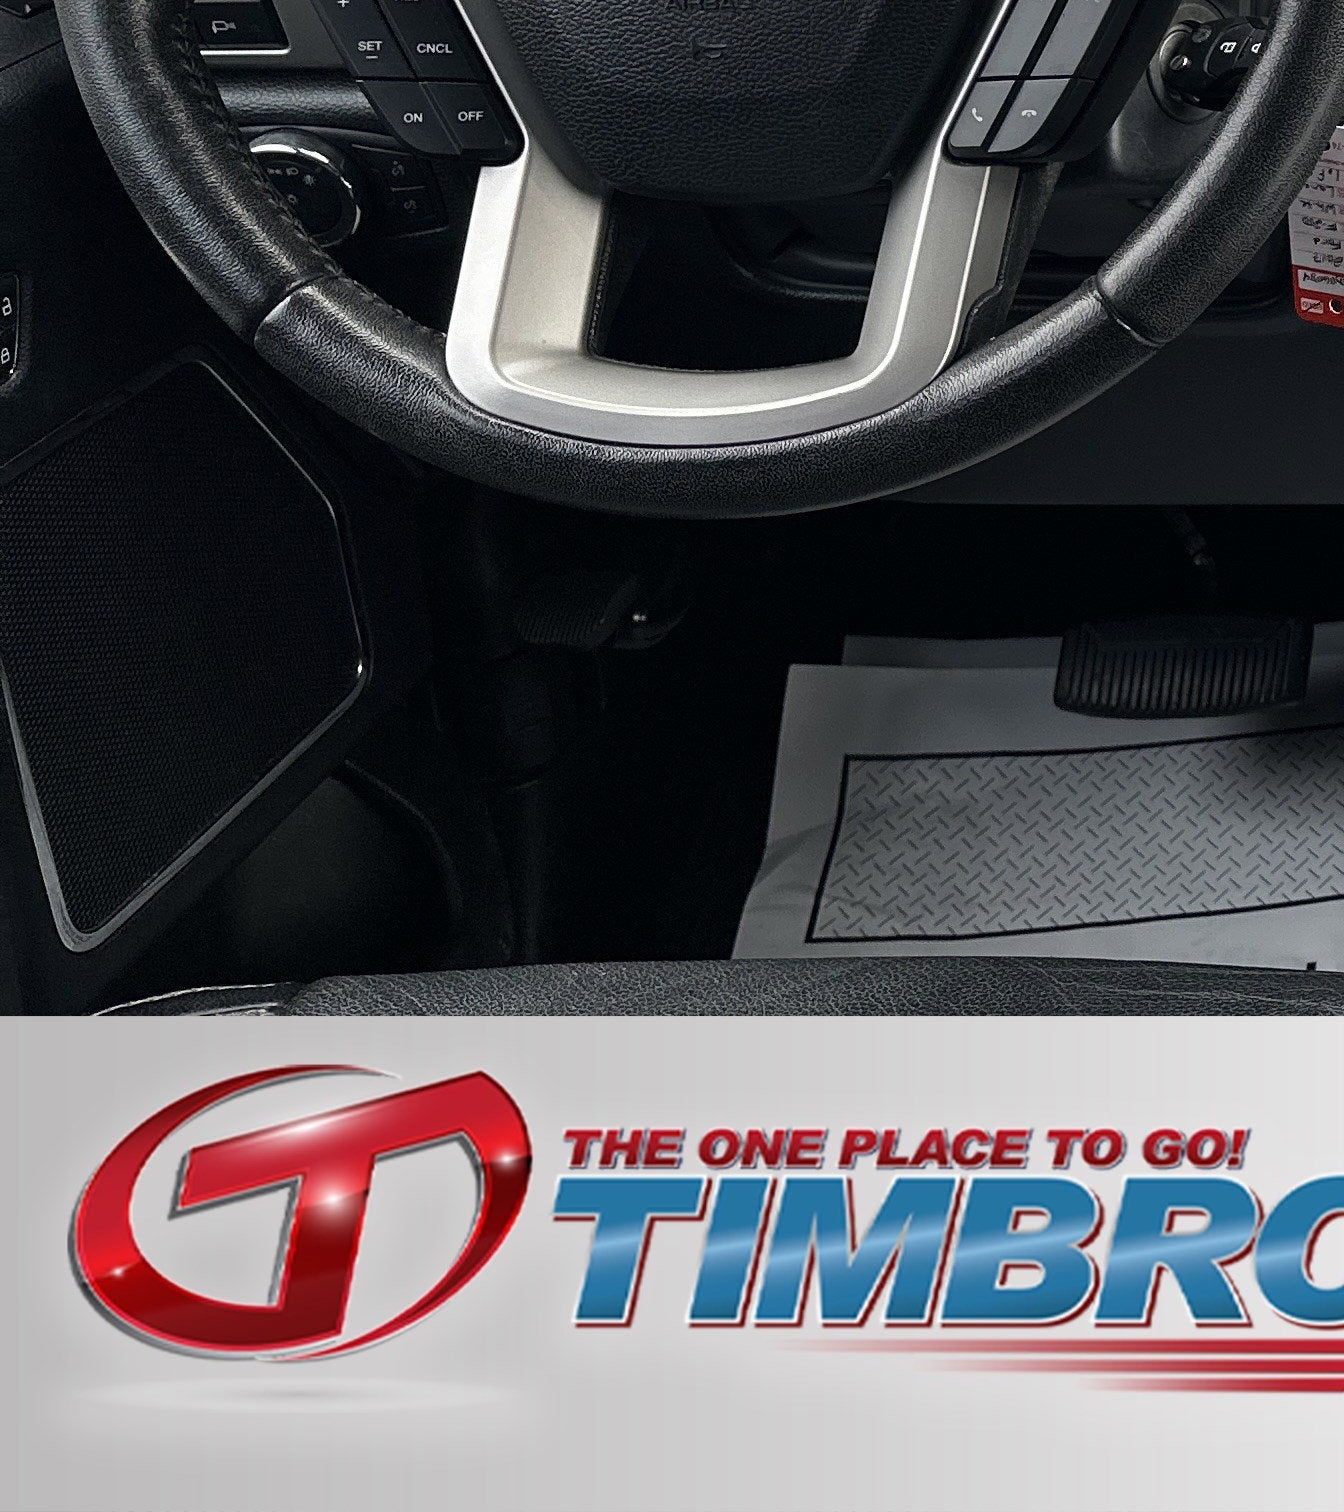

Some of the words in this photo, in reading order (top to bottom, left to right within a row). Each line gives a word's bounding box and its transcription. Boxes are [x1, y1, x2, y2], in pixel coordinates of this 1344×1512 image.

[357, 40, 383, 53] SET
[416, 42, 453, 55] CNCL
[403, 112, 423, 124] ON
[457, 110, 484, 123] OFF
